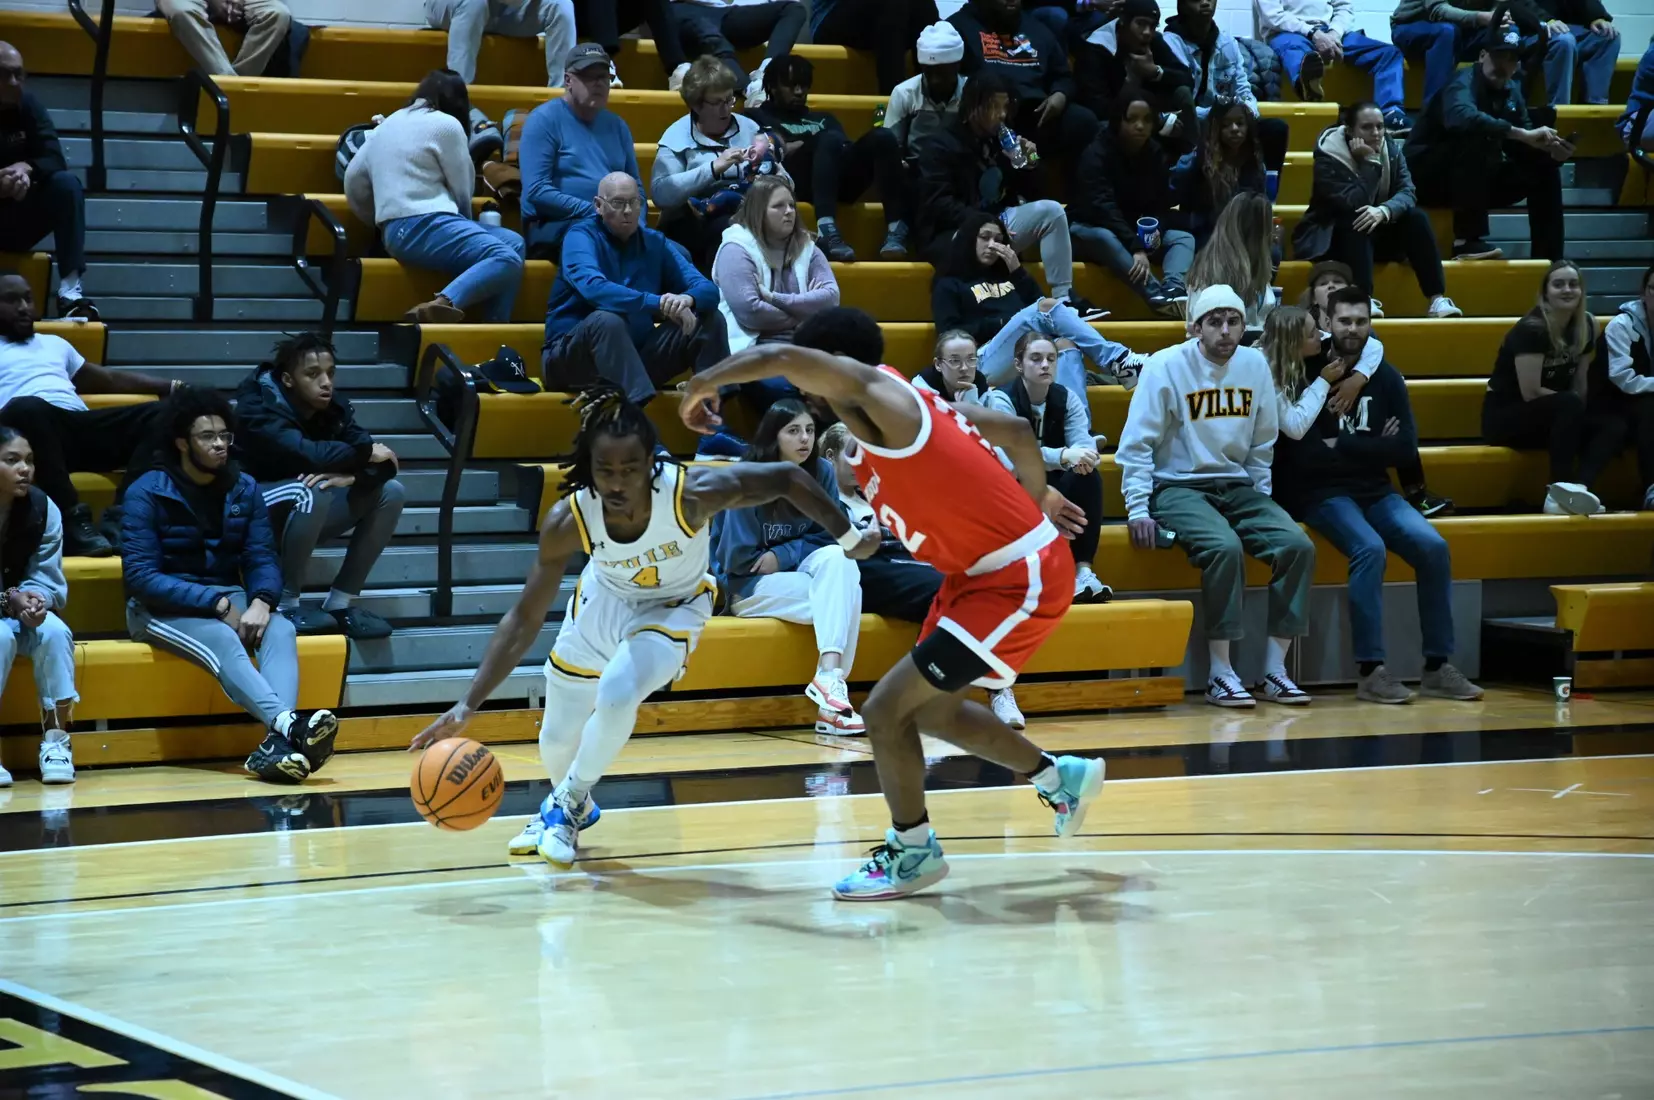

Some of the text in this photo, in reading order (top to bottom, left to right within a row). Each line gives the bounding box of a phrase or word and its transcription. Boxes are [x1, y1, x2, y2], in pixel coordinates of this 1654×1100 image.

[1186, 387, 1254, 421] VILLE
[629, 565, 661, 589] 4
[446, 746, 489, 786] Wilson
